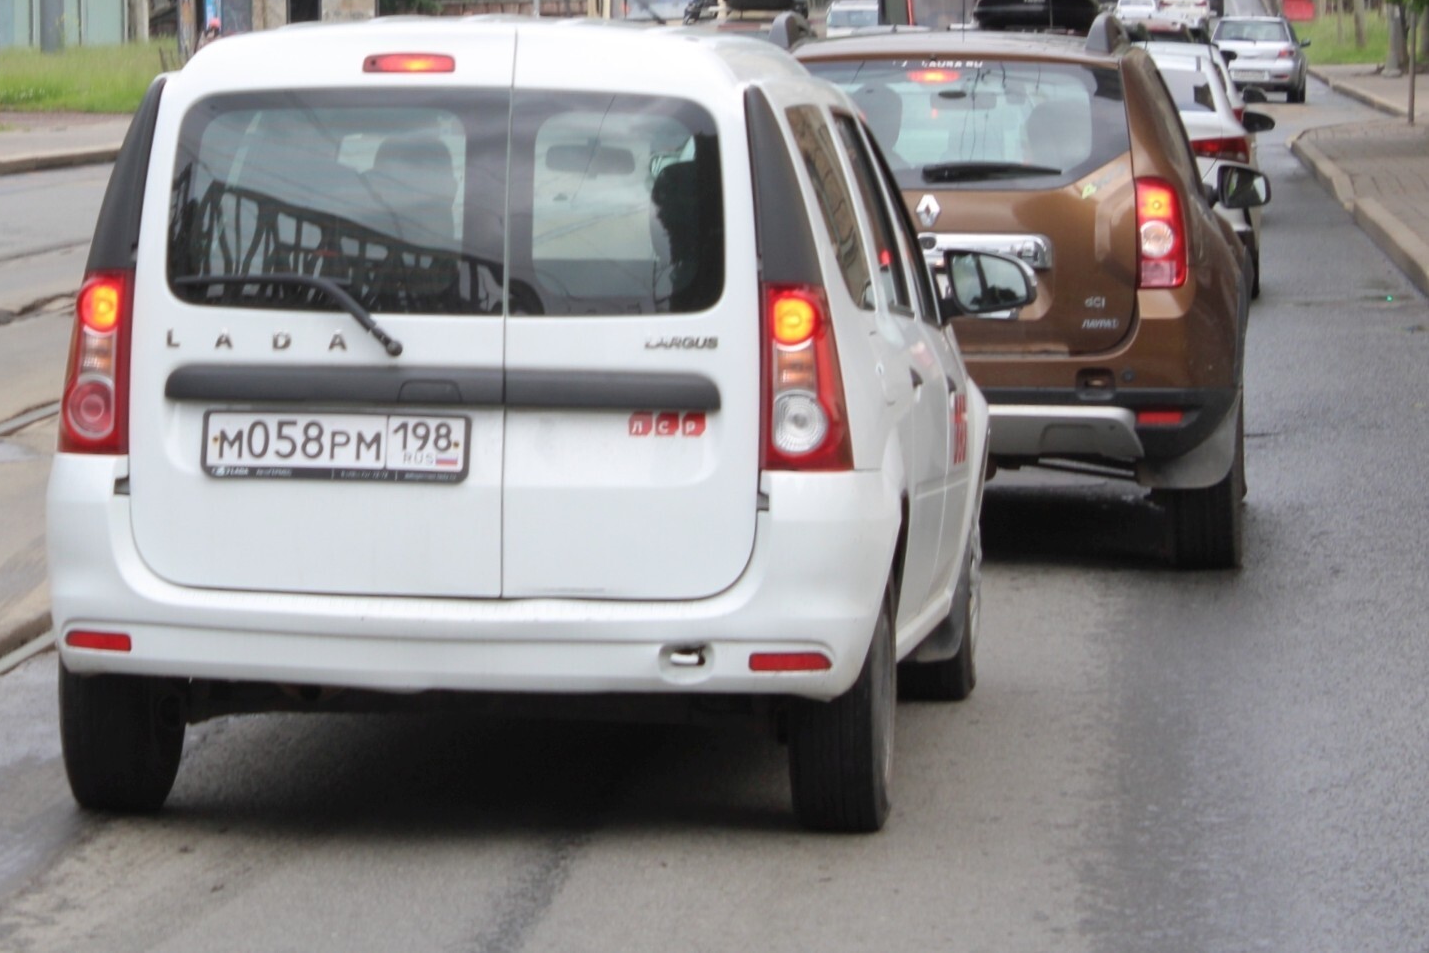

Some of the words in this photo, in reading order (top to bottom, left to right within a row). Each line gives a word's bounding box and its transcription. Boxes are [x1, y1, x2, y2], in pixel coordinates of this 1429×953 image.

[166, 328, 347, 351] LADA
[644, 336, 718, 350] LARGUS
[630, 417, 700, 435] ЛСР
[392, 421, 453, 453] 198
[403, 452, 434, 466] RUS
